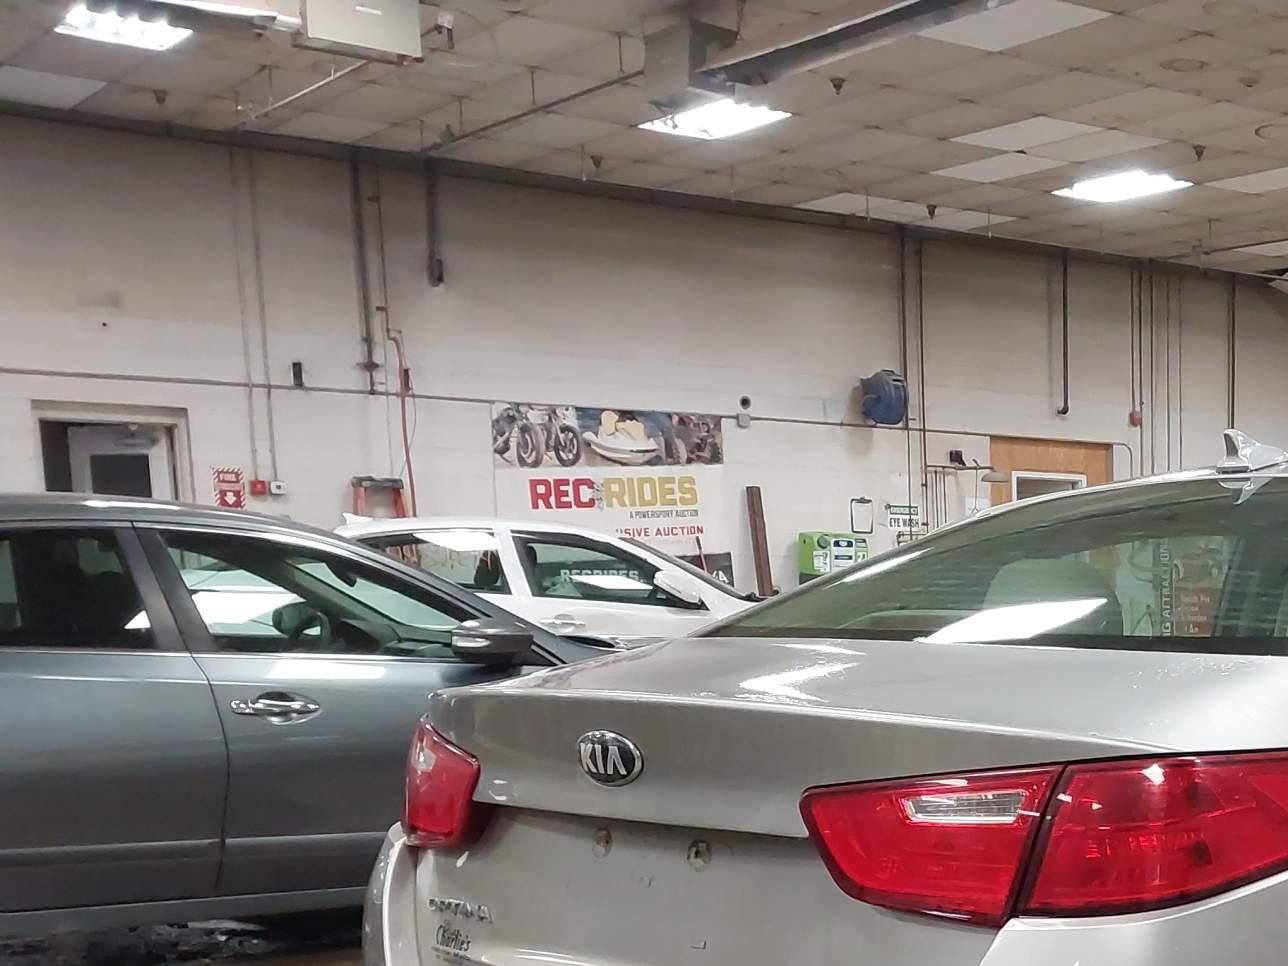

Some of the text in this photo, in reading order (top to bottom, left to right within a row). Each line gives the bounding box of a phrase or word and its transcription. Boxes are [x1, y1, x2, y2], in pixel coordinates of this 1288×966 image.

[529, 478, 595, 509] REC
[604, 476, 698, 507] RIDES
[655, 525, 704, 537] AUCTION
[889, 517, 920, 528] EYE WASH
[580, 742, 627, 775] KIA
